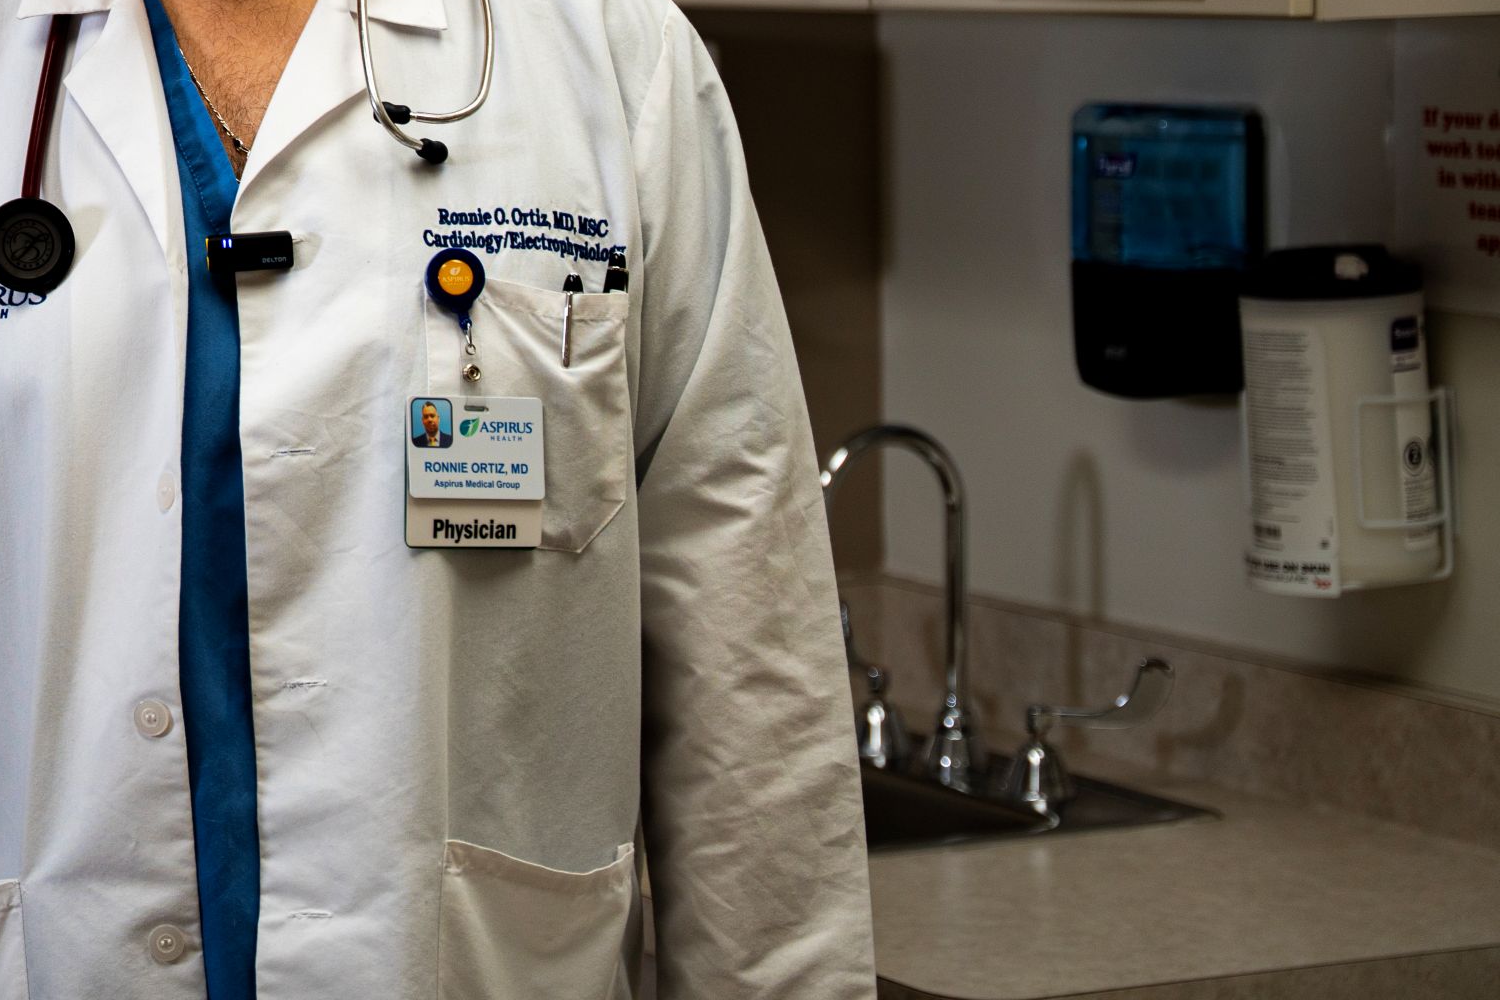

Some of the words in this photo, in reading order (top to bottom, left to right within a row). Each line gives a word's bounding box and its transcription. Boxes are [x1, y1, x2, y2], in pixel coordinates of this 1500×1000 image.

[1424, 108, 1438, 127] If
[1443, 112, 1482, 132] your
[1428, 139, 1471, 159] work
[1439, 166, 1456, 188] in
[437, 208, 491, 226] Ronnie
[494, 207, 509, 226] O.
[511, 207, 551, 229] Ortiz,
[553, 210, 577, 233] MD,
[578, 215, 609, 238] MSC
[480, 421, 533, 434] ASPIRUS
[424, 462, 468, 473] RONNIE
[471, 463, 508, 475] ORTIZ,
[511, 464, 529, 474] MD
[434, 479, 463, 489] Aspirus
[465, 480, 494, 488] Medical
[496, 481, 521, 490] Group
[433, 519, 516, 544] Physician
